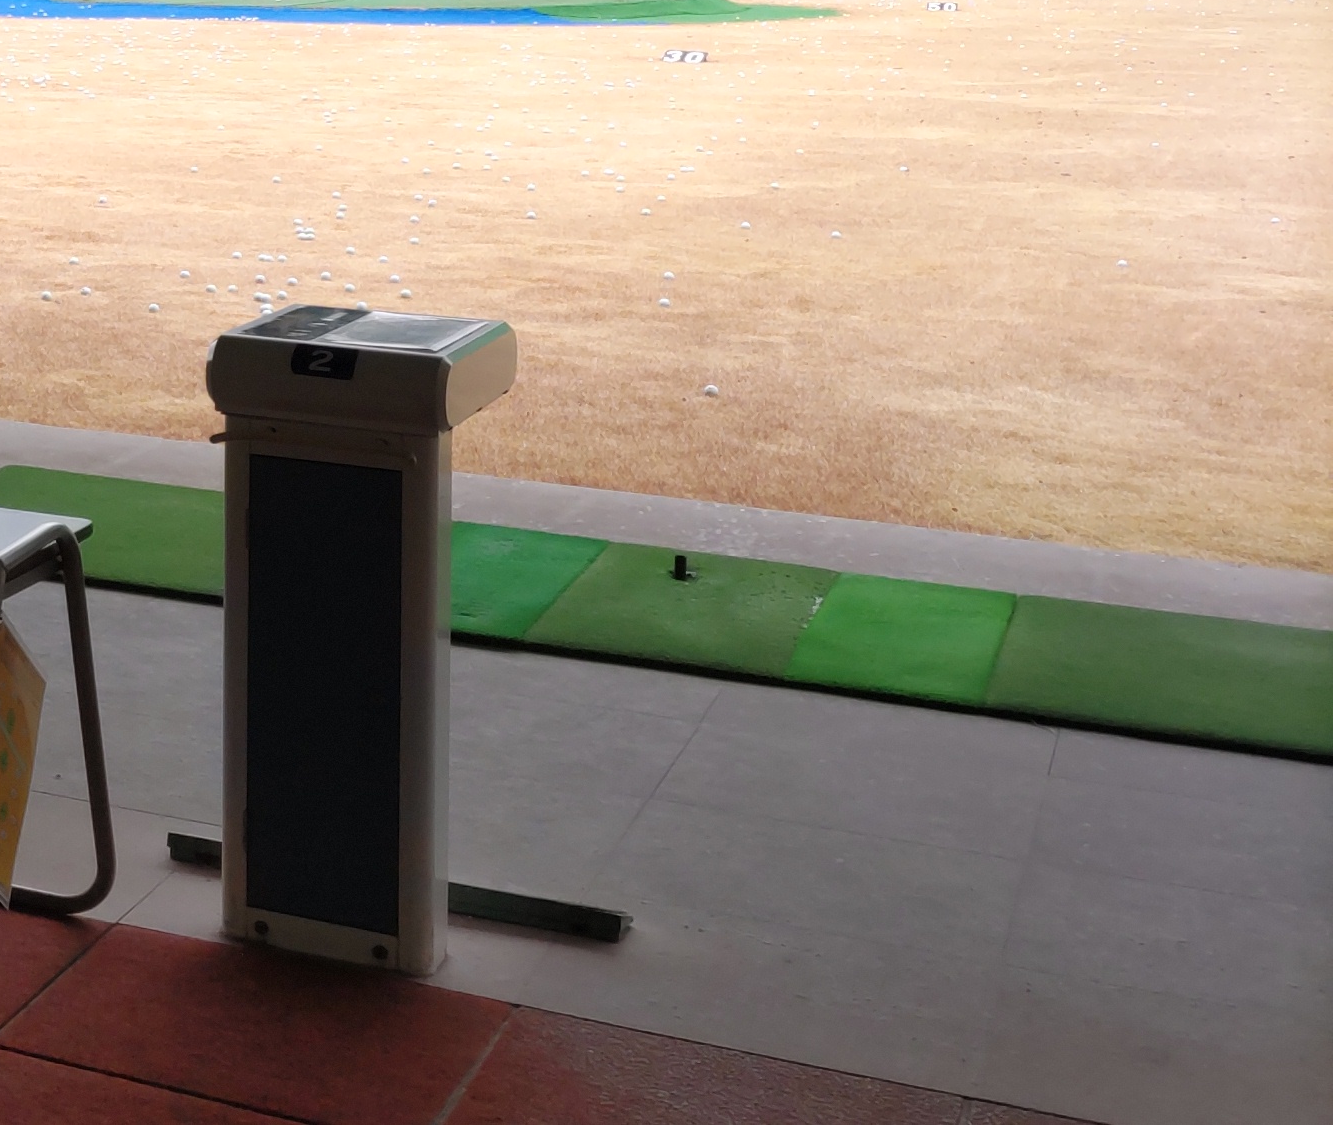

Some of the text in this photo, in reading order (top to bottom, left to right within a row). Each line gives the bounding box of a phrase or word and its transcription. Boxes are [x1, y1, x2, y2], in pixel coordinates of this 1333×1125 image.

[927, 2, 957, 12] 50
[662, 49, 706, 64] 30
[307, 349, 334, 373] 2
